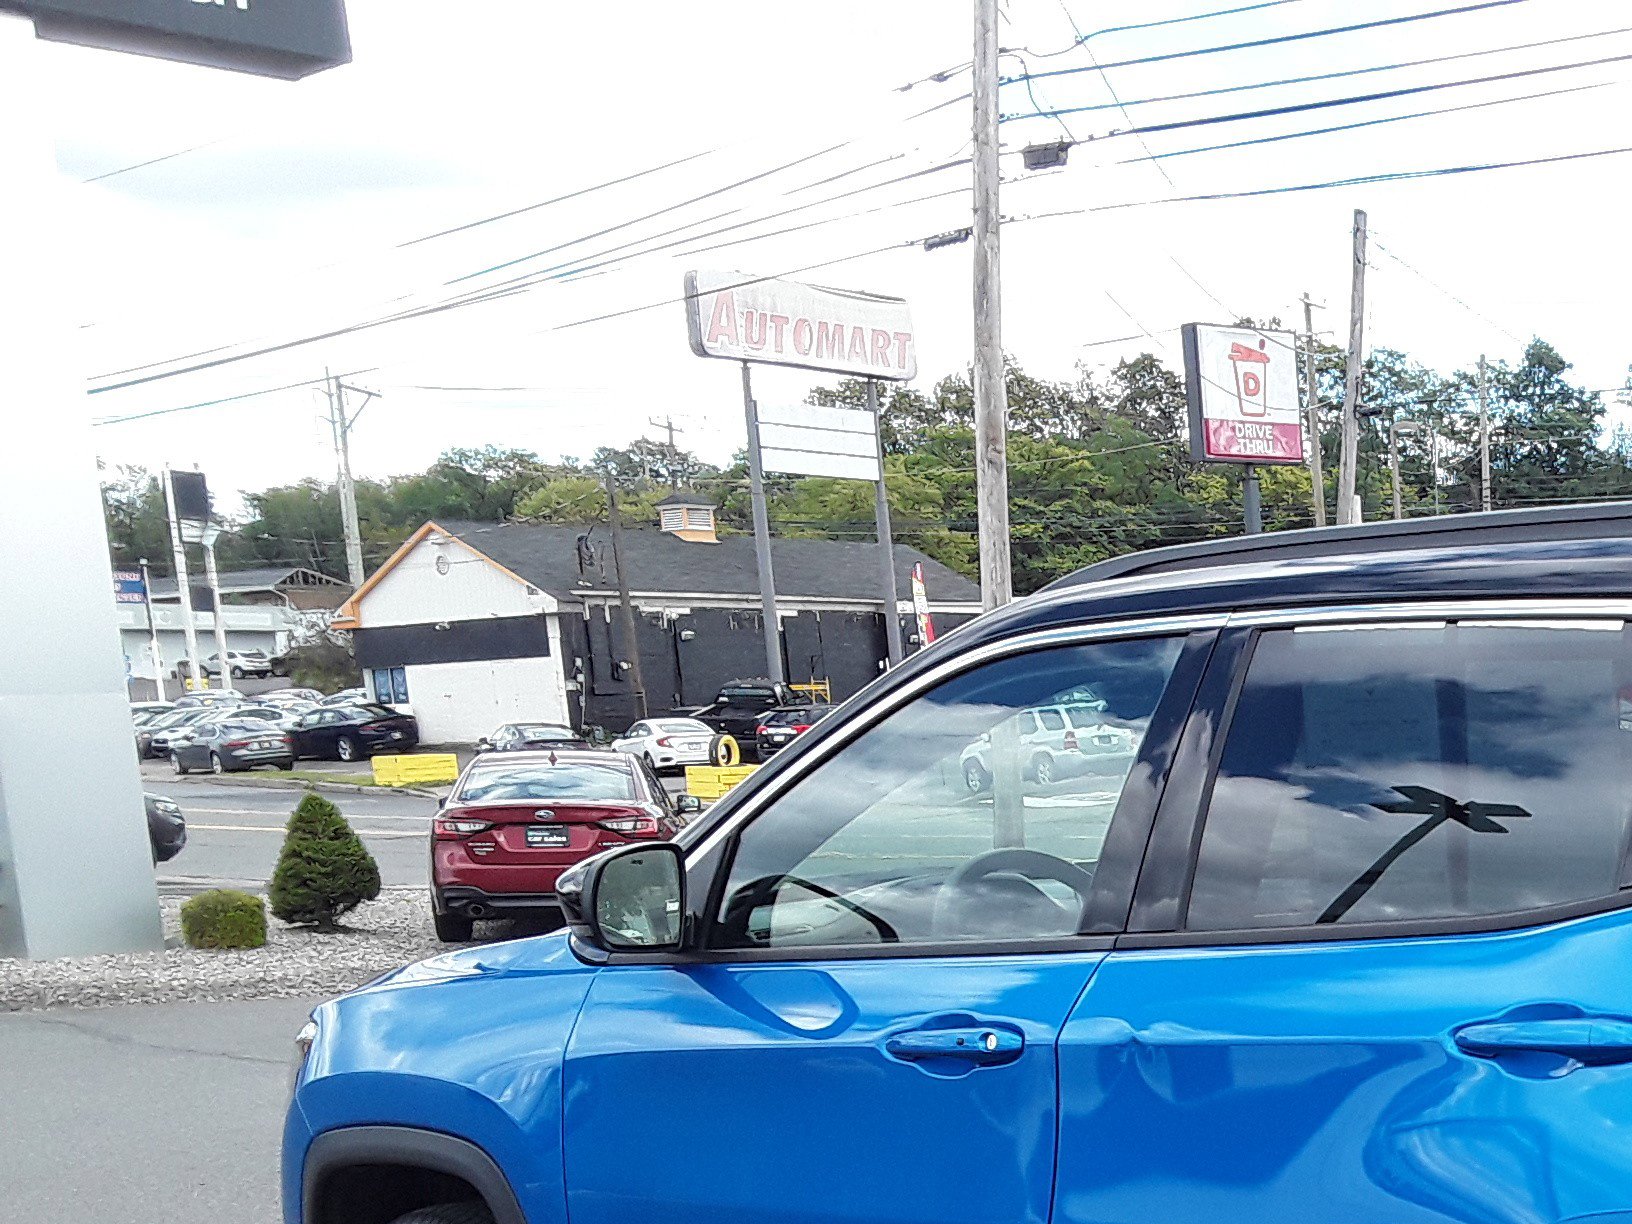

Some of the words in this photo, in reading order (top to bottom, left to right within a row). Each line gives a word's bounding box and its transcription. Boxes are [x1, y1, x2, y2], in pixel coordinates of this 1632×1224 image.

[1243, 372, 1260, 396] D
[1235, 424, 1274, 440] DRIVE
[1238, 439, 1274, 454] THRU
